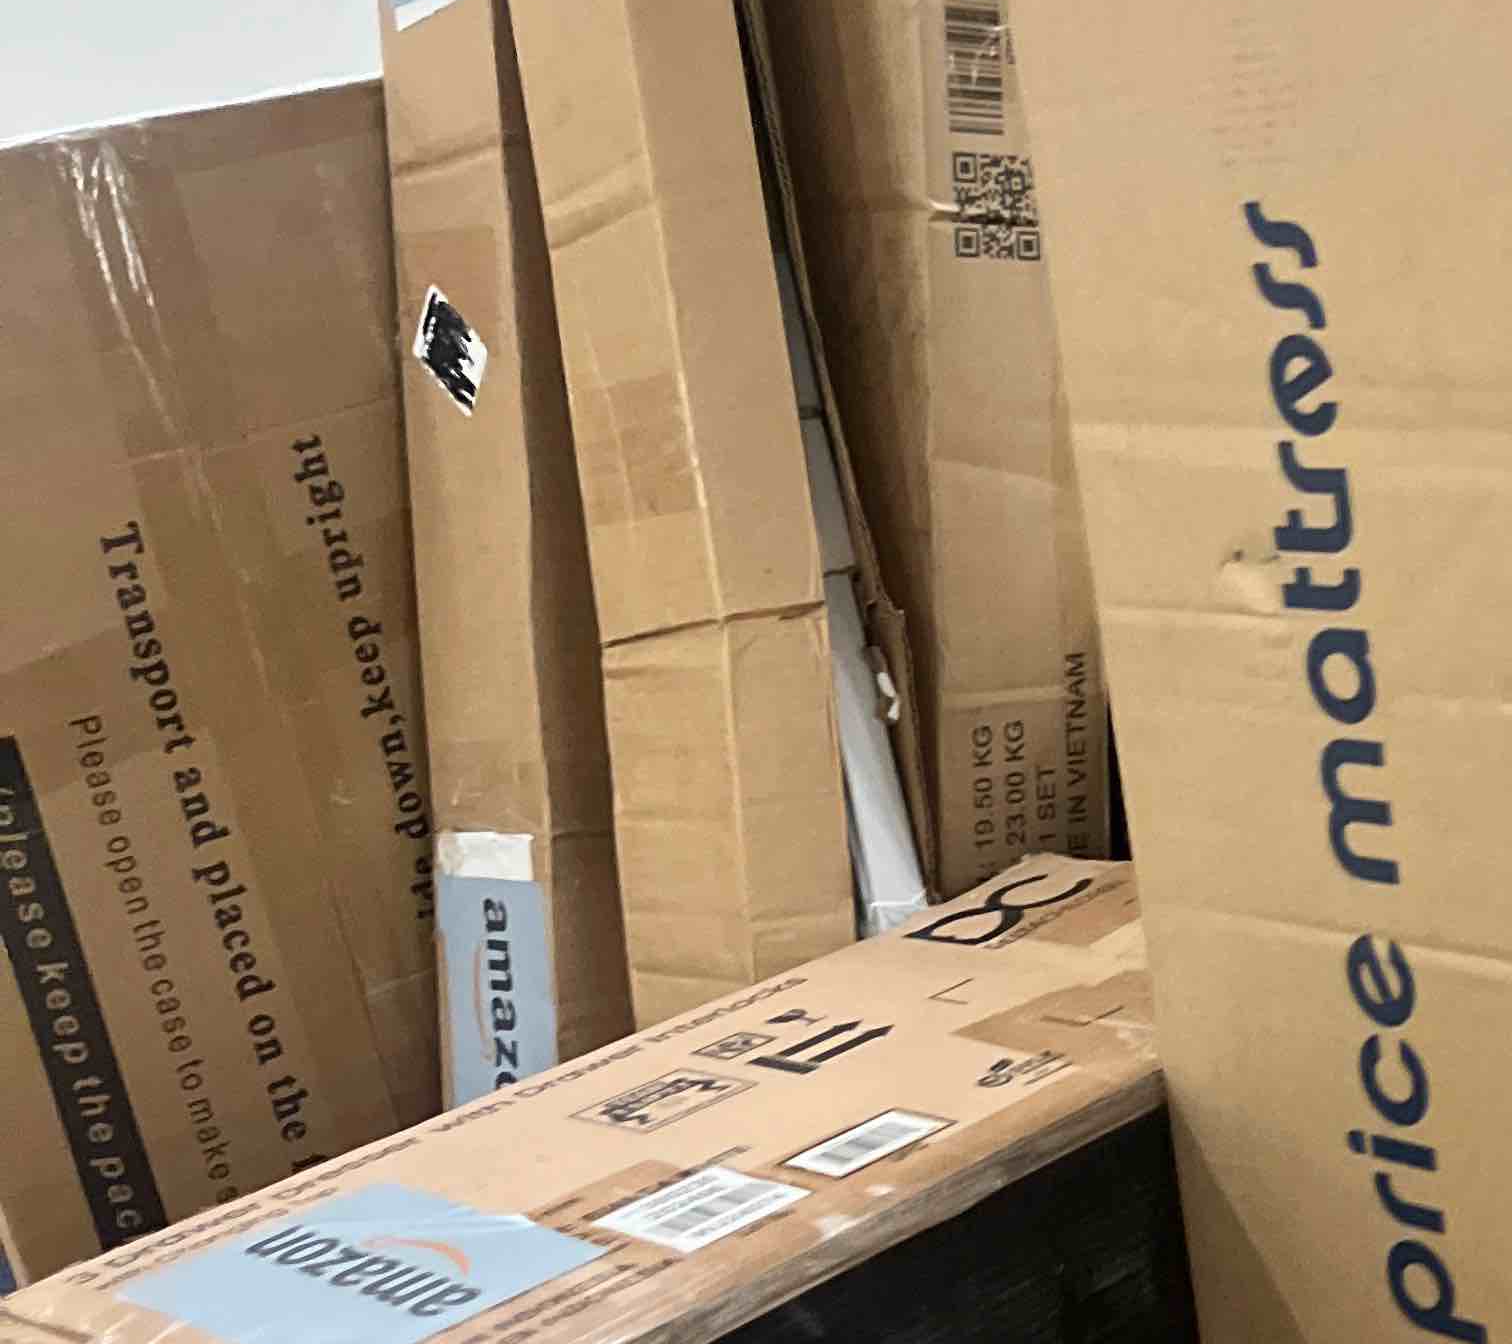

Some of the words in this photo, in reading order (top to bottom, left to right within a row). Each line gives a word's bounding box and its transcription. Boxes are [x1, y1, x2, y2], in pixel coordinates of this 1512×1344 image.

[293, 433, 365, 602] upright
[1244, 199, 1402, 886] mattress
[99, 520, 198, 755] Transport
[970, 723, 994, 769] KG
[1003, 718, 1025, 763] KG
[1064, 650, 1089, 794] VIETNAM
[67, 714, 124, 826] Please
[173, 766, 232, 849] and
[1004, 770, 1026, 848] 23.00
[1035, 765, 1057, 821] SET
[1066, 795, 1088, 825] IN
[972, 777, 995, 849] 19.50
[103, 834, 150, 916] open
[191, 860, 276, 1002] placed
[36, 960, 90, 1066] keep
[71, 1075, 115, 1145] the
[150, 978, 193, 1053] case
[248, 1013, 284, 1066] on
[176, 1058, 206, 1092] to
[266, 1074, 310, 1144] the
[186, 1096, 233, 1182] make
[244, 1223, 483, 1318] amazon
